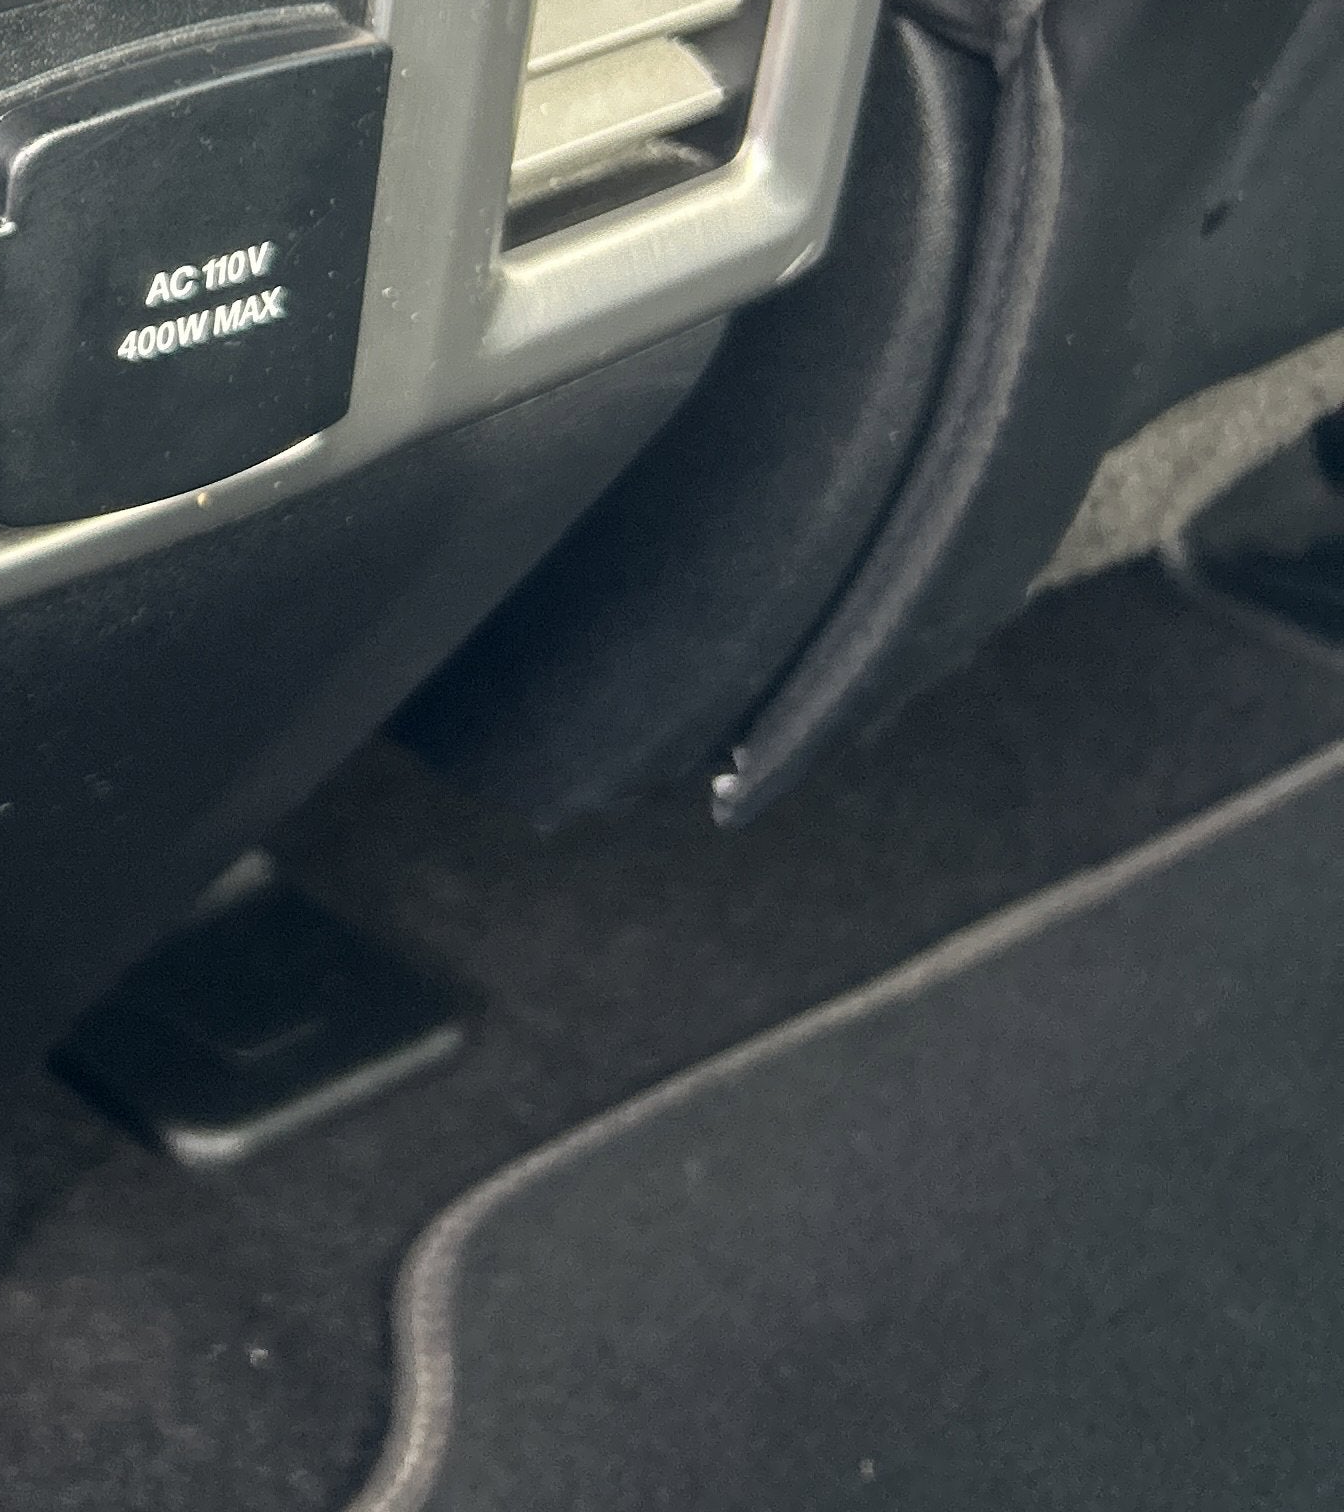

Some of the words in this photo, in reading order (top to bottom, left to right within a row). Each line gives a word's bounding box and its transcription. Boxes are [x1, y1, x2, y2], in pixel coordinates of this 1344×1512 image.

[145, 265, 198, 307] AC
[201, 240, 277, 290] 110V
[117, 309, 211, 361] 400W
[213, 285, 289, 337] MAX
